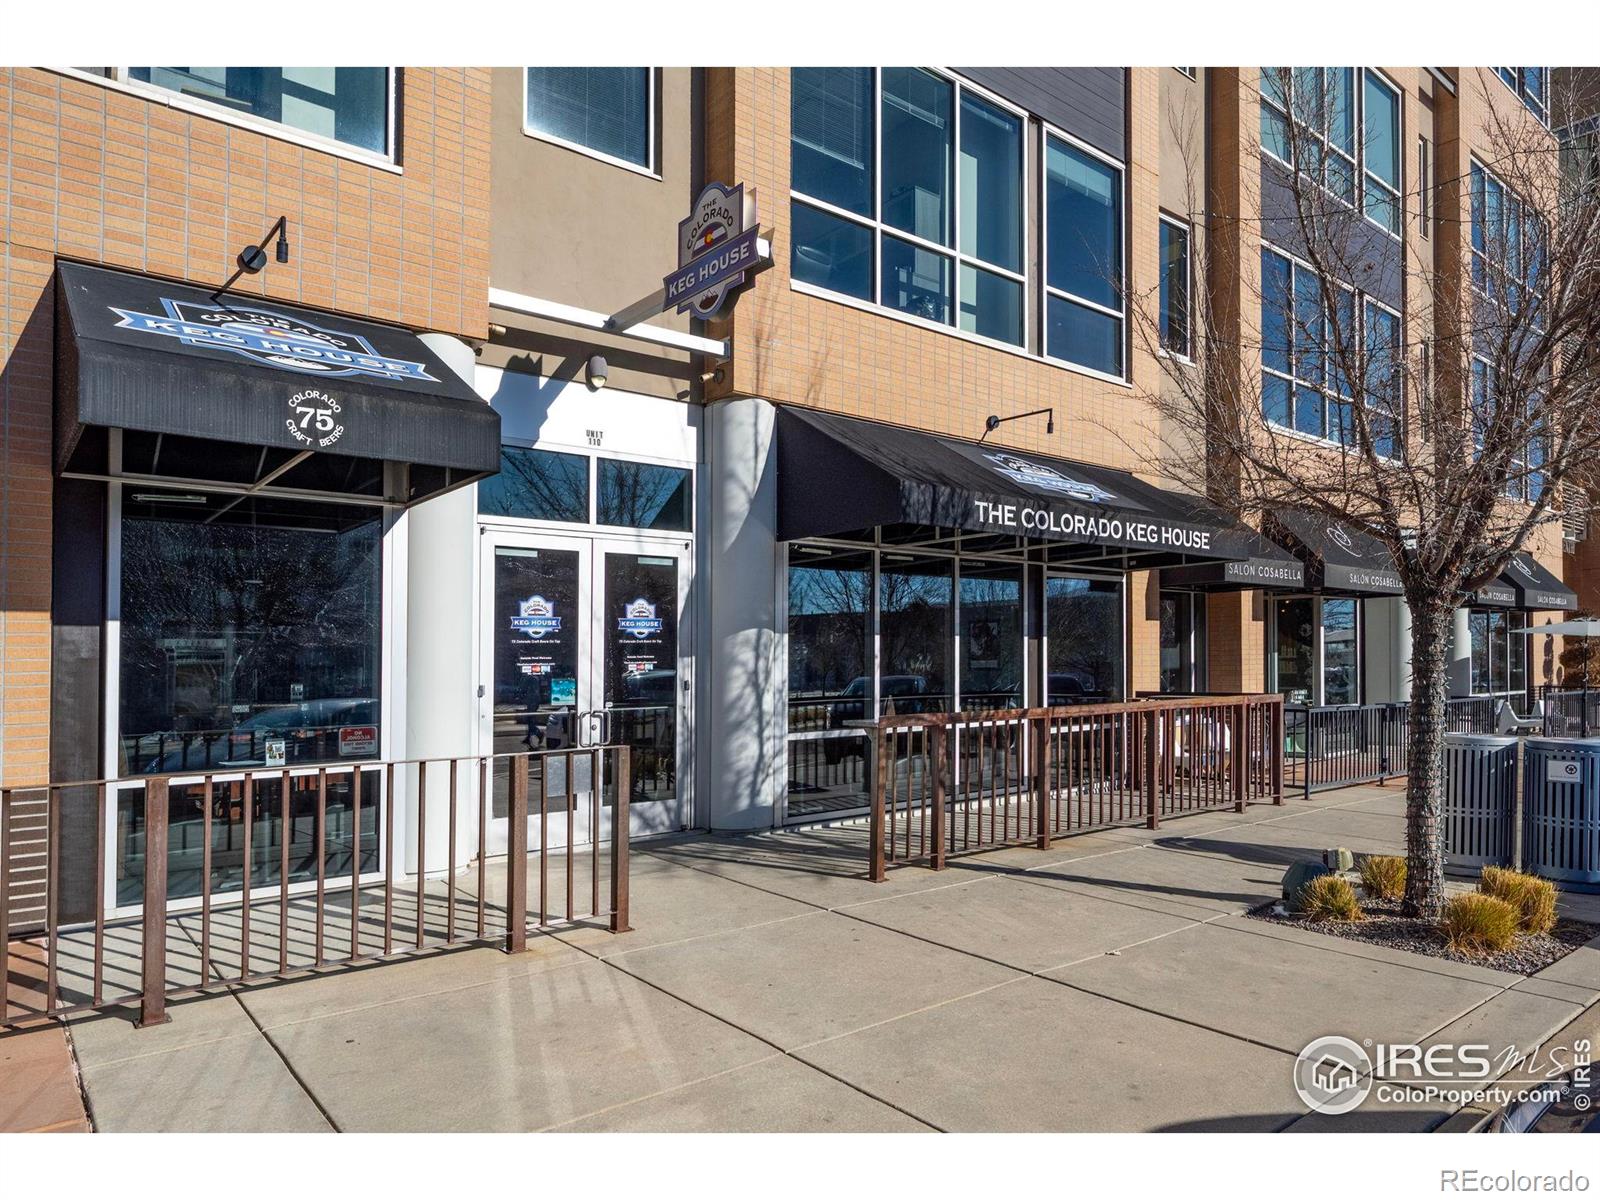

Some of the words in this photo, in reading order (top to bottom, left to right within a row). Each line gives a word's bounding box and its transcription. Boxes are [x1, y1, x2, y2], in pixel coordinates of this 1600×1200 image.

[702, 198, 717, 211] THE
[687, 206, 734, 250] COLORADO
[668, 273, 695, 298] KEG
[699, 241, 750, 282] HOUSE
[200, 314, 348, 347] COLORADO
[245, 313, 290, 325] THE
[144, 319, 248, 344] KEG
[260, 340, 412, 373] HOUSE
[288, 390, 341, 413] COLORADO
[296, 406, 334, 431] 75
[286, 419, 313, 445] CRAFT
[319, 424, 344, 446] BEERS
[586, 429, 603, 439] UNIT
[974, 500, 1017, 526] THE
[1021, 508, 1123, 539] COLORADO
[1126, 522, 1158, 543] KEG
[1161, 526, 1210, 550] HOUSE
[1229, 563, 1255, 576] SALON
[1258, 566, 1301, 580] COSABELLA
[1371, 575, 1404, 588] COSABELLA
